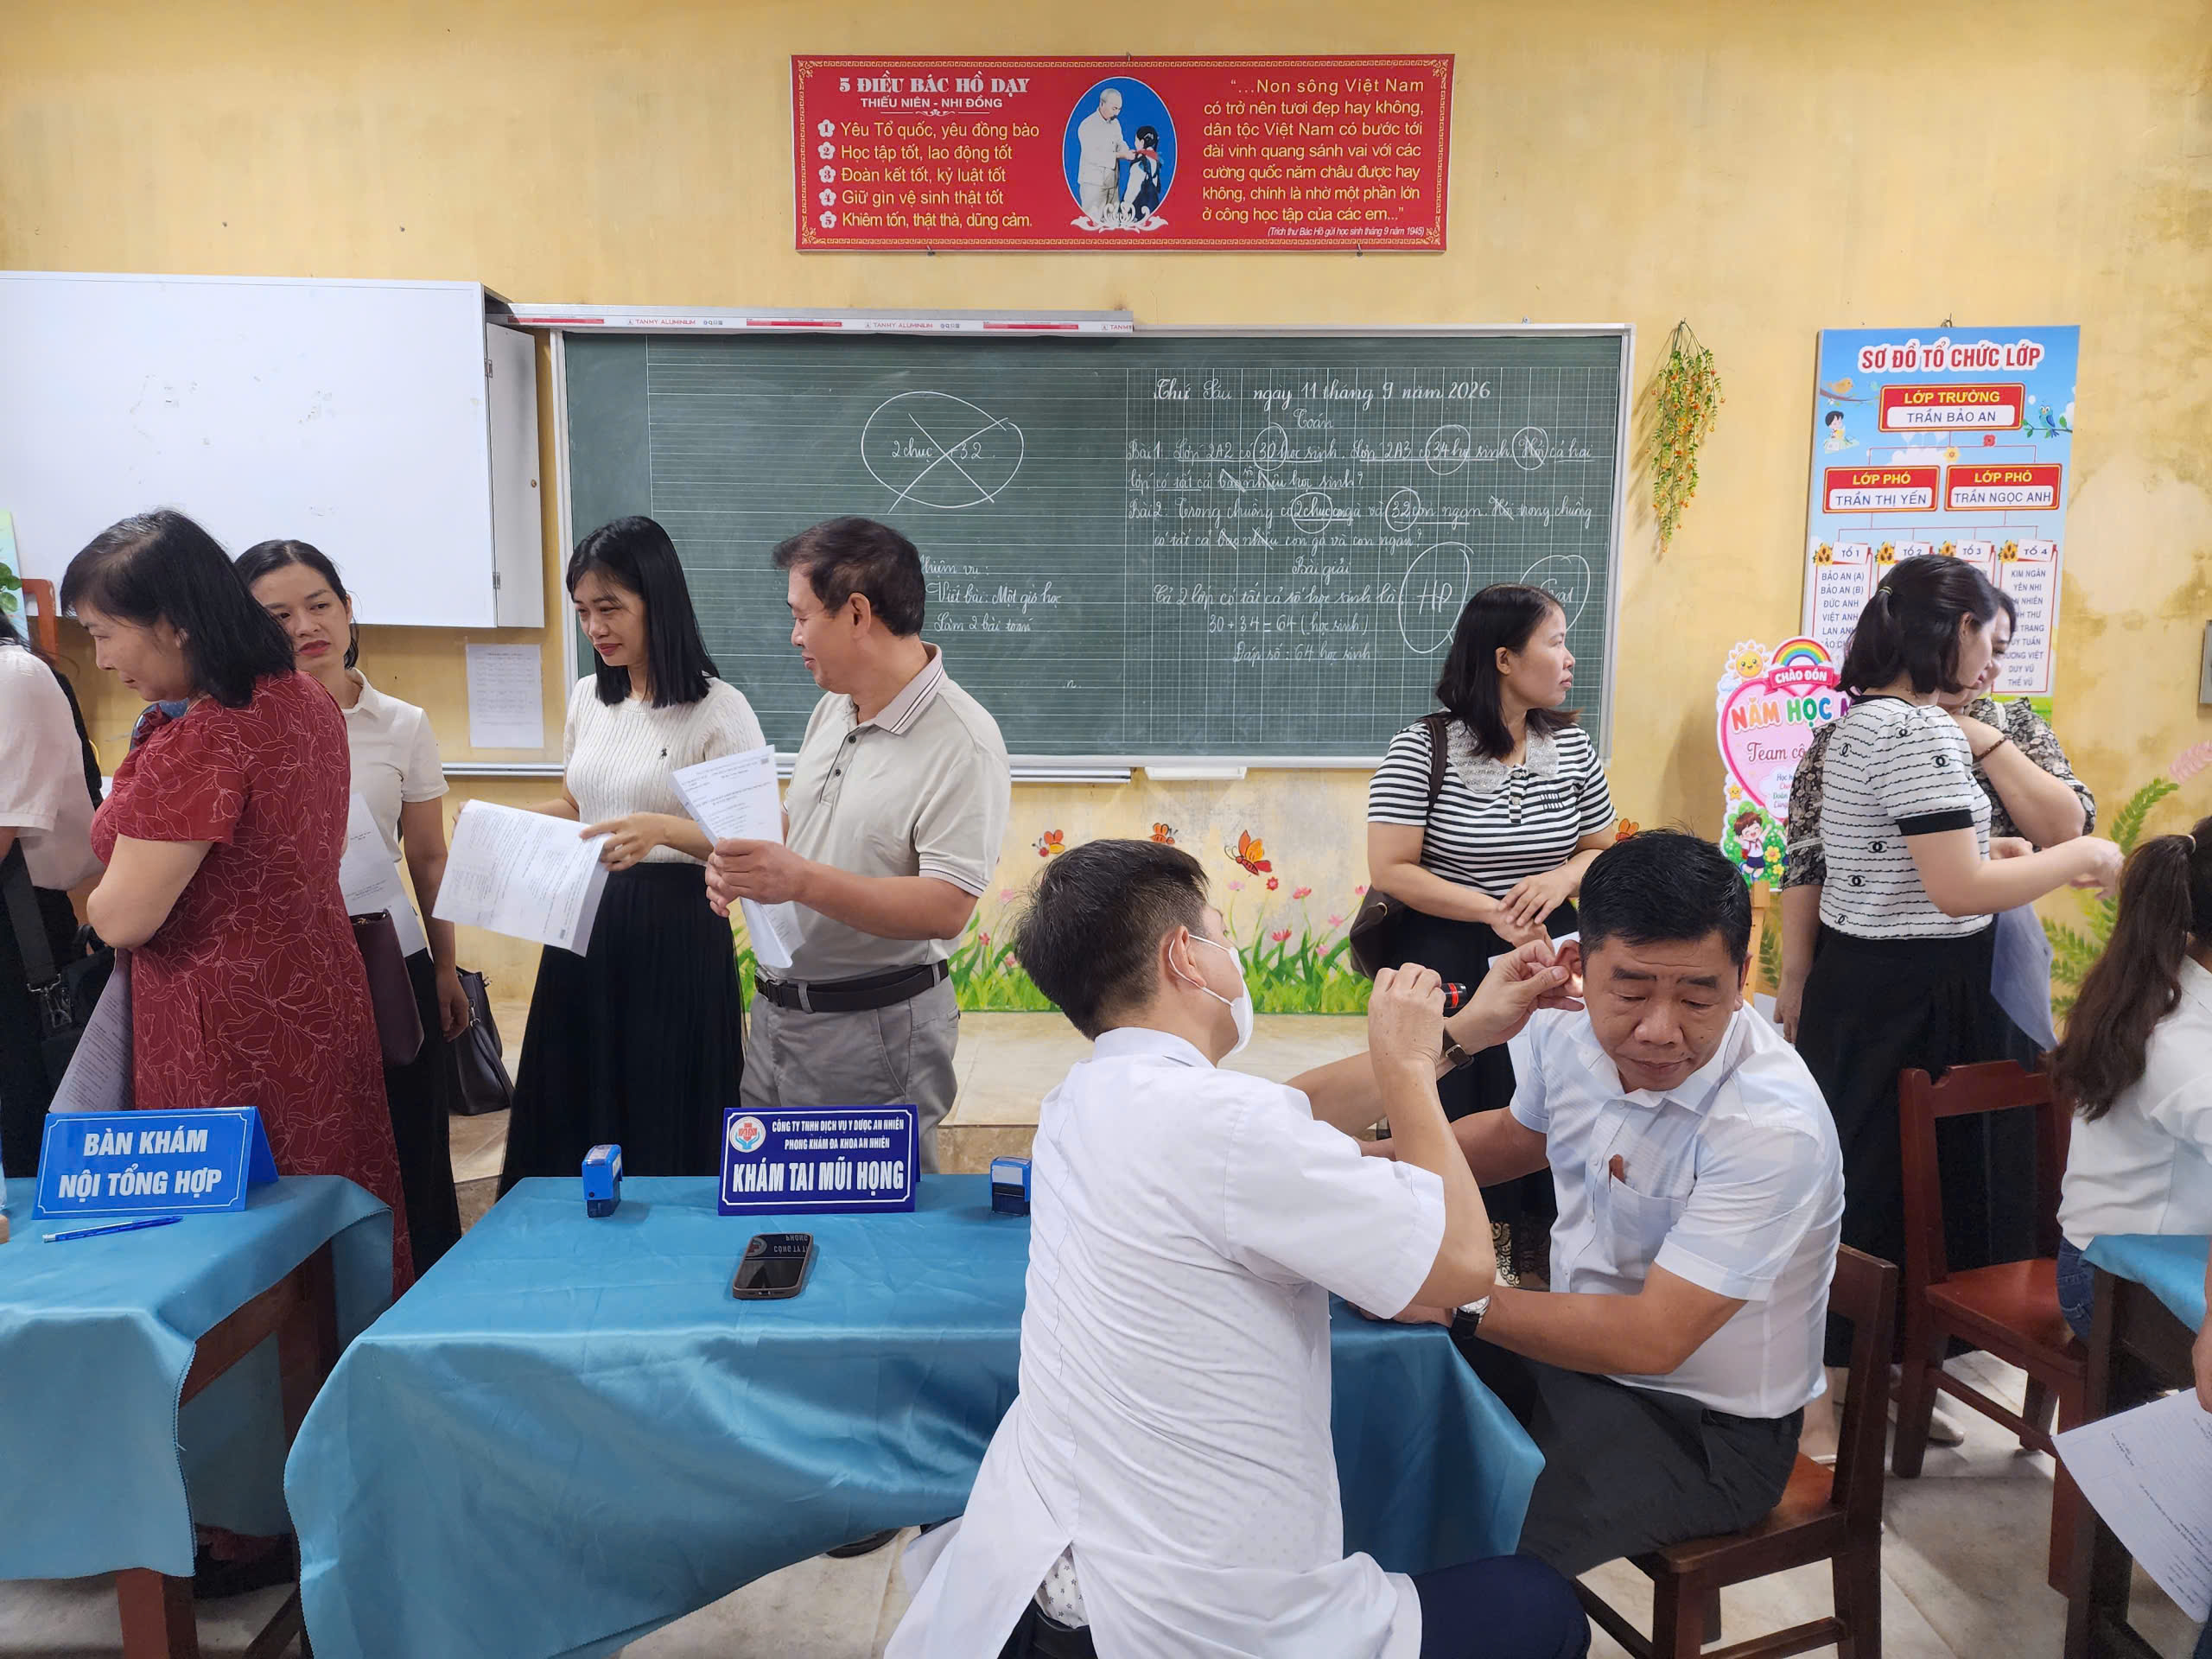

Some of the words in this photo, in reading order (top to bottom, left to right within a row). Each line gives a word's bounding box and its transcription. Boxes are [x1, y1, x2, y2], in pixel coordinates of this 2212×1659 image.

[839, 78, 850, 92] 5
[857, 70, 904, 92] ĐIỀU
[911, 74, 949, 92] BÁC
[956, 71, 983, 92] HỒ
[991, 78, 1030, 97] DẠY
[1298, 79, 1338, 95] sông
[1345, 79, 1379, 95] Việt
[1385, 79, 1424, 92] Nam
[861, 96, 897, 107] THIẾU
[901, 97, 930, 107] NIÊN
[942, 99, 963, 107] NHI
[966, 95, 1002, 107] ĐỒNG
[1205, 102, 1221, 114] có
[1226, 102, 1245, 114] trở
[1249, 103, 1275, 114] nên
[1281, 103, 1307, 114] tươi
[1313, 102, 1339, 118] đẹp
[1345, 101, 1370, 117] hay
[1376, 100, 1424, 117] không,
[841, 122, 869, 137] Yêu
[874, 120, 893, 137] Tổ
[898, 121, 937, 140] quốc,
[942, 123, 969, 140] yêu
[972, 121, 1007, 140] đồng
[1013, 122, 1039, 137] bào
[1204, 123, 1230, 136] dân
[1237, 123, 1259, 138] tộc
[1264, 123, 1294, 138] Việt
[1300, 123, 1333, 135] Nam
[1339, 123, 1357, 135] có
[1363, 122, 1400, 135] bước
[1405, 122, 1422, 135] tới
[842, 145, 869, 163] Học
[874, 147, 897, 163] tập
[900, 144, 923, 162] tốt,
[928, 145, 949, 159] lao
[954, 145, 988, 162] động
[995, 144, 1012, 159] tốt
[842, 168, 880, 181] Đoàn
[885, 167, 906, 181] kết
[911, 166, 931, 183] tốt,
[937, 168, 952, 185] kỷ
[958, 168, 983, 184] luật
[988, 166, 1006, 181] tốt
[842, 190, 868, 204] Giữ
[873, 191, 893, 207] gìn
[899, 192, 916, 207] vệ
[921, 190, 949, 204] sinh
[955, 190, 980, 207] thật
[985, 189, 1003, 204] tốt
[842, 213, 882, 226] Khiêm
[887, 212, 909, 228] tốn,
[913, 213, 936, 230] thật
[940, 213, 963, 228] thà,
[967, 213, 997, 230] dũng
[1002, 213, 1032, 226] cảm.
[1862, 347, 1886, 368] SƠ
[1892, 342, 1916, 368] ĐỒ
[1923, 340, 1946, 367] TỔ
[1951, 346, 1999, 366] CHỨC
[2006, 344, 2041, 366] LỚP
[1253, 385, 1293, 411] ngày
[1300, 381, 1317, 398] 11
[1323, 378, 1374, 410] tháng
[1383, 381, 1393, 399] 9
[1402, 385, 1444, 399] năm
[1447, 381, 1491, 399] 2026
[1904, 390, 1934, 404] LỚP
[1947, 408, 1974, 422] BẢO
[1978, 411, 1996, 422] AN
[1853, 473, 1880, 485] LỚP
[1883, 472, 1911, 484] PHÓ
[1974, 470, 2002, 483] LỚP
[1875, 494, 1896, 506] THỊ
[1901, 490, 1927, 505] YẾN
[1989, 492, 2024, 505] NGỌC
[2026, 492, 2051, 502] ANH
[1853, 572, 1865, 582] (A)
[1177, 588, 1187, 604] 2
[1853, 587, 1864, 595] (B)
[969, 615, 977, 630] 2
[1775, 669, 1803, 683] CHÀO
[1804, 668, 1827, 682] ĐÓN
[1731, 697, 1780, 732] NĂM
[1787, 697, 1832, 728] HỌC
[1747, 741, 1788, 762] Team
[772, 1118, 791, 1133] CÔNG
[791, 1121, 800, 1131] TY
[801, 1121, 819, 1131] TNHH
[821, 1120, 837, 1134] DỊCH
[838, 1120, 847, 1134] VỤ
[849, 1120, 853, 1130] Y
[873, 1120, 882, 1130] AN
[883, 1116, 905, 1130] NHIÊN
[83, 1128, 133, 1156] BÀN
[139, 1125, 208, 1154] KHÁM
[809, 1135, 829, 1149] KHÁM
[830, 1138, 838, 1148] ĐA
[840, 1137, 857, 1149] KHOA
[859, 1138, 868, 1148] AN
[869, 1135, 890, 1148] NHIÊN
[58, 1170, 100, 1203] NỘI
[107, 1163, 168, 1197] TỔNG
[174, 1166, 222, 1198] HỢP
[733, 1158, 785, 1192] KHÁM
[790, 1162, 814, 1192] TAI
[818, 1156, 852, 1191] MŨI
[857, 1160, 904, 1196] HỌNG
